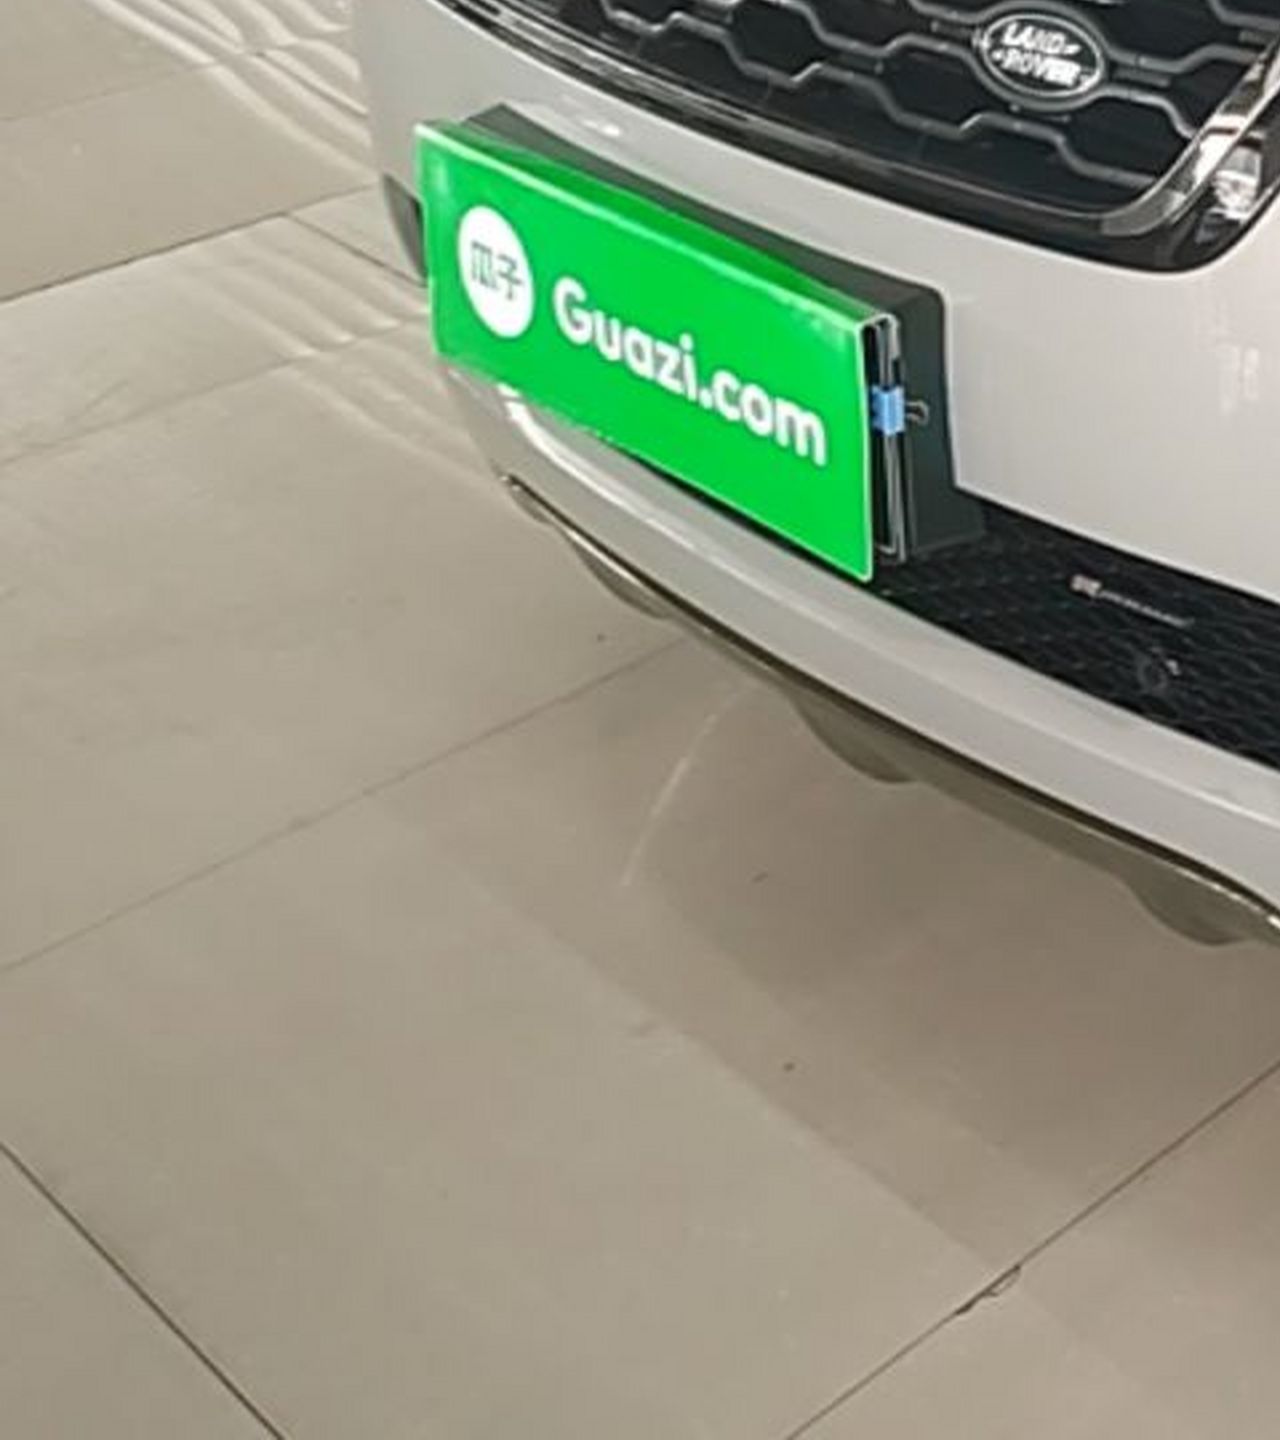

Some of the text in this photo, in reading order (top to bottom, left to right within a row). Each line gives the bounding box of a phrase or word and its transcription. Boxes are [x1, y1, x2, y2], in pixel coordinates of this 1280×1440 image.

[1002, 21, 1069, 54] LAND
[471, 241, 525, 301] 瓜子
[553, 276, 827, 468] Guazi.com
